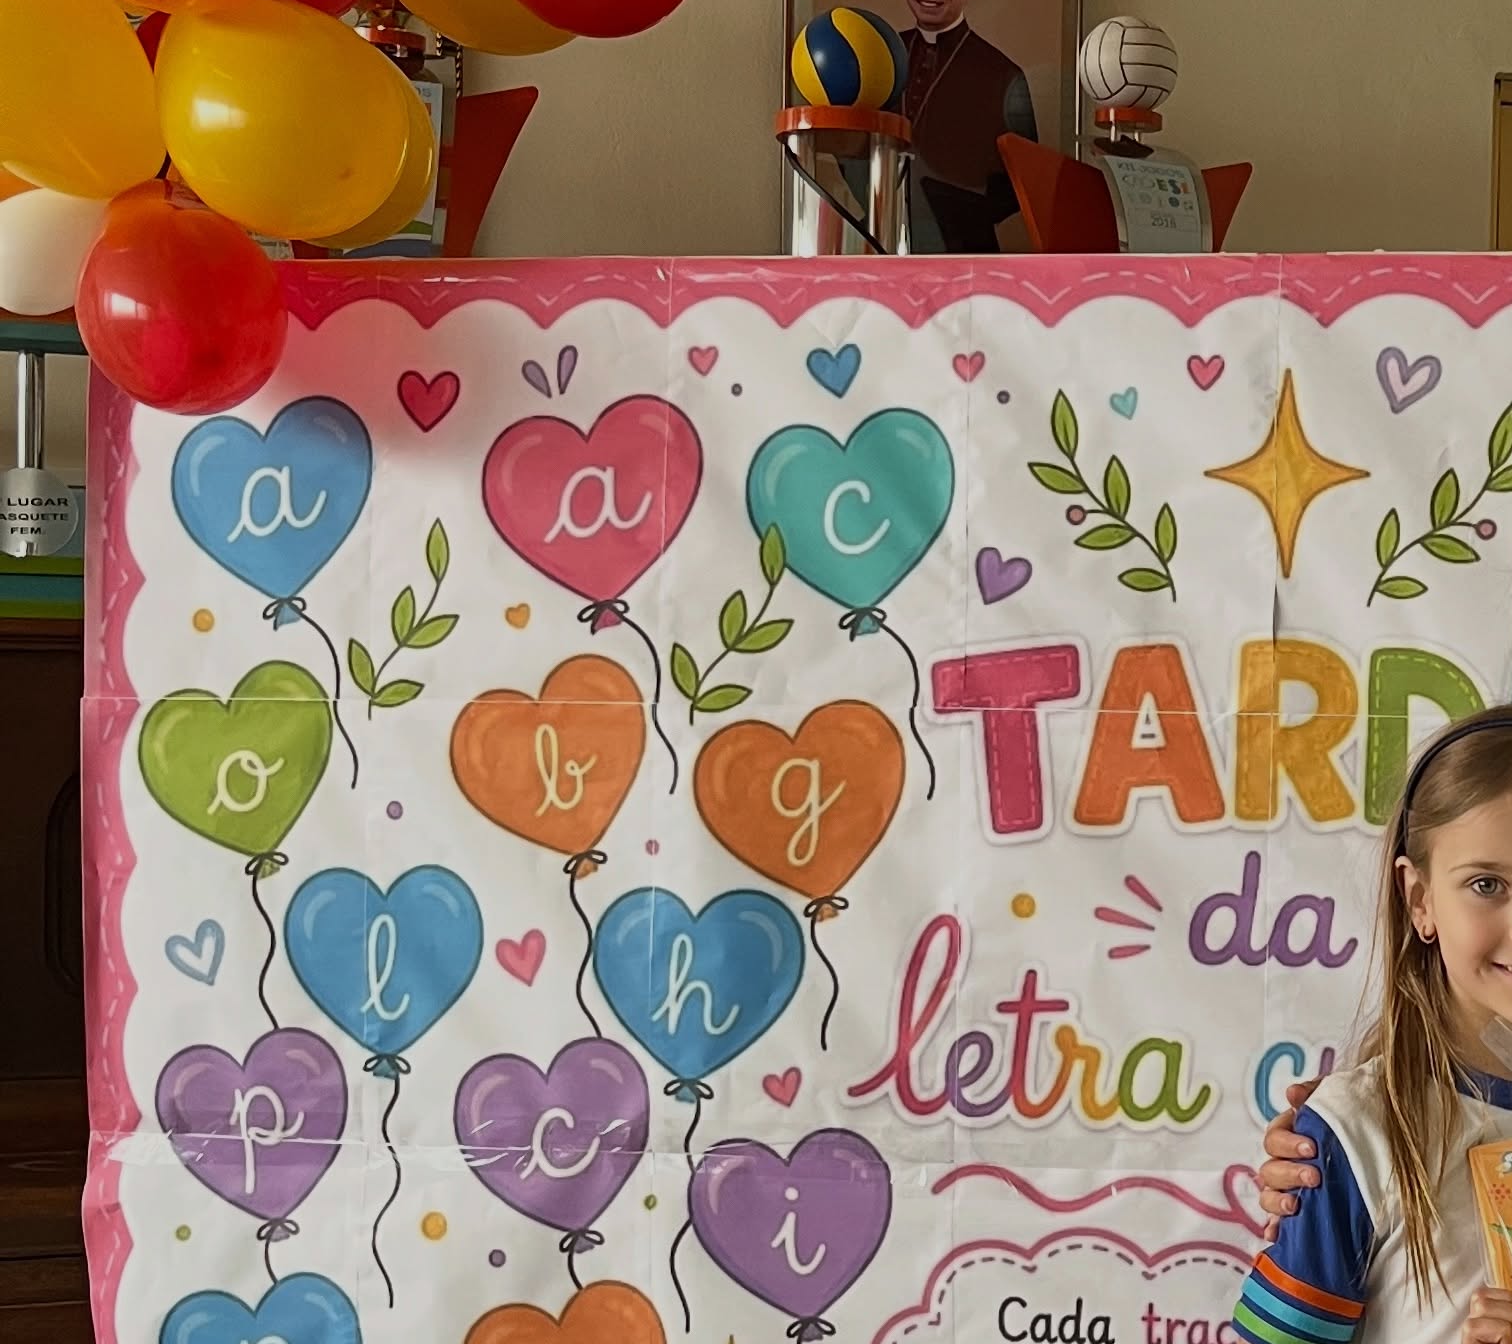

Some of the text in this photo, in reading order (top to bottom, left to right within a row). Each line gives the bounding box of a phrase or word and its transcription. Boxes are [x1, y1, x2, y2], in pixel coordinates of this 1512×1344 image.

[7, 498, 68, 507] LUGAR
[227, 465, 327, 542] a
[543, 464, 652, 544] a
[824, 480, 891, 555] c
[207, 749, 285, 817] o
[534, 723, 597, 818] b
[771, 757, 847, 867] g
[1188, 850, 1359, 967] da
[652, 933, 739, 1036] h
[847, 914, 1211, 1123] letra
[230, 1085, 304, 1195] p
[519, 1107, 600, 1180] c
[770, 1186, 827, 1276] i
